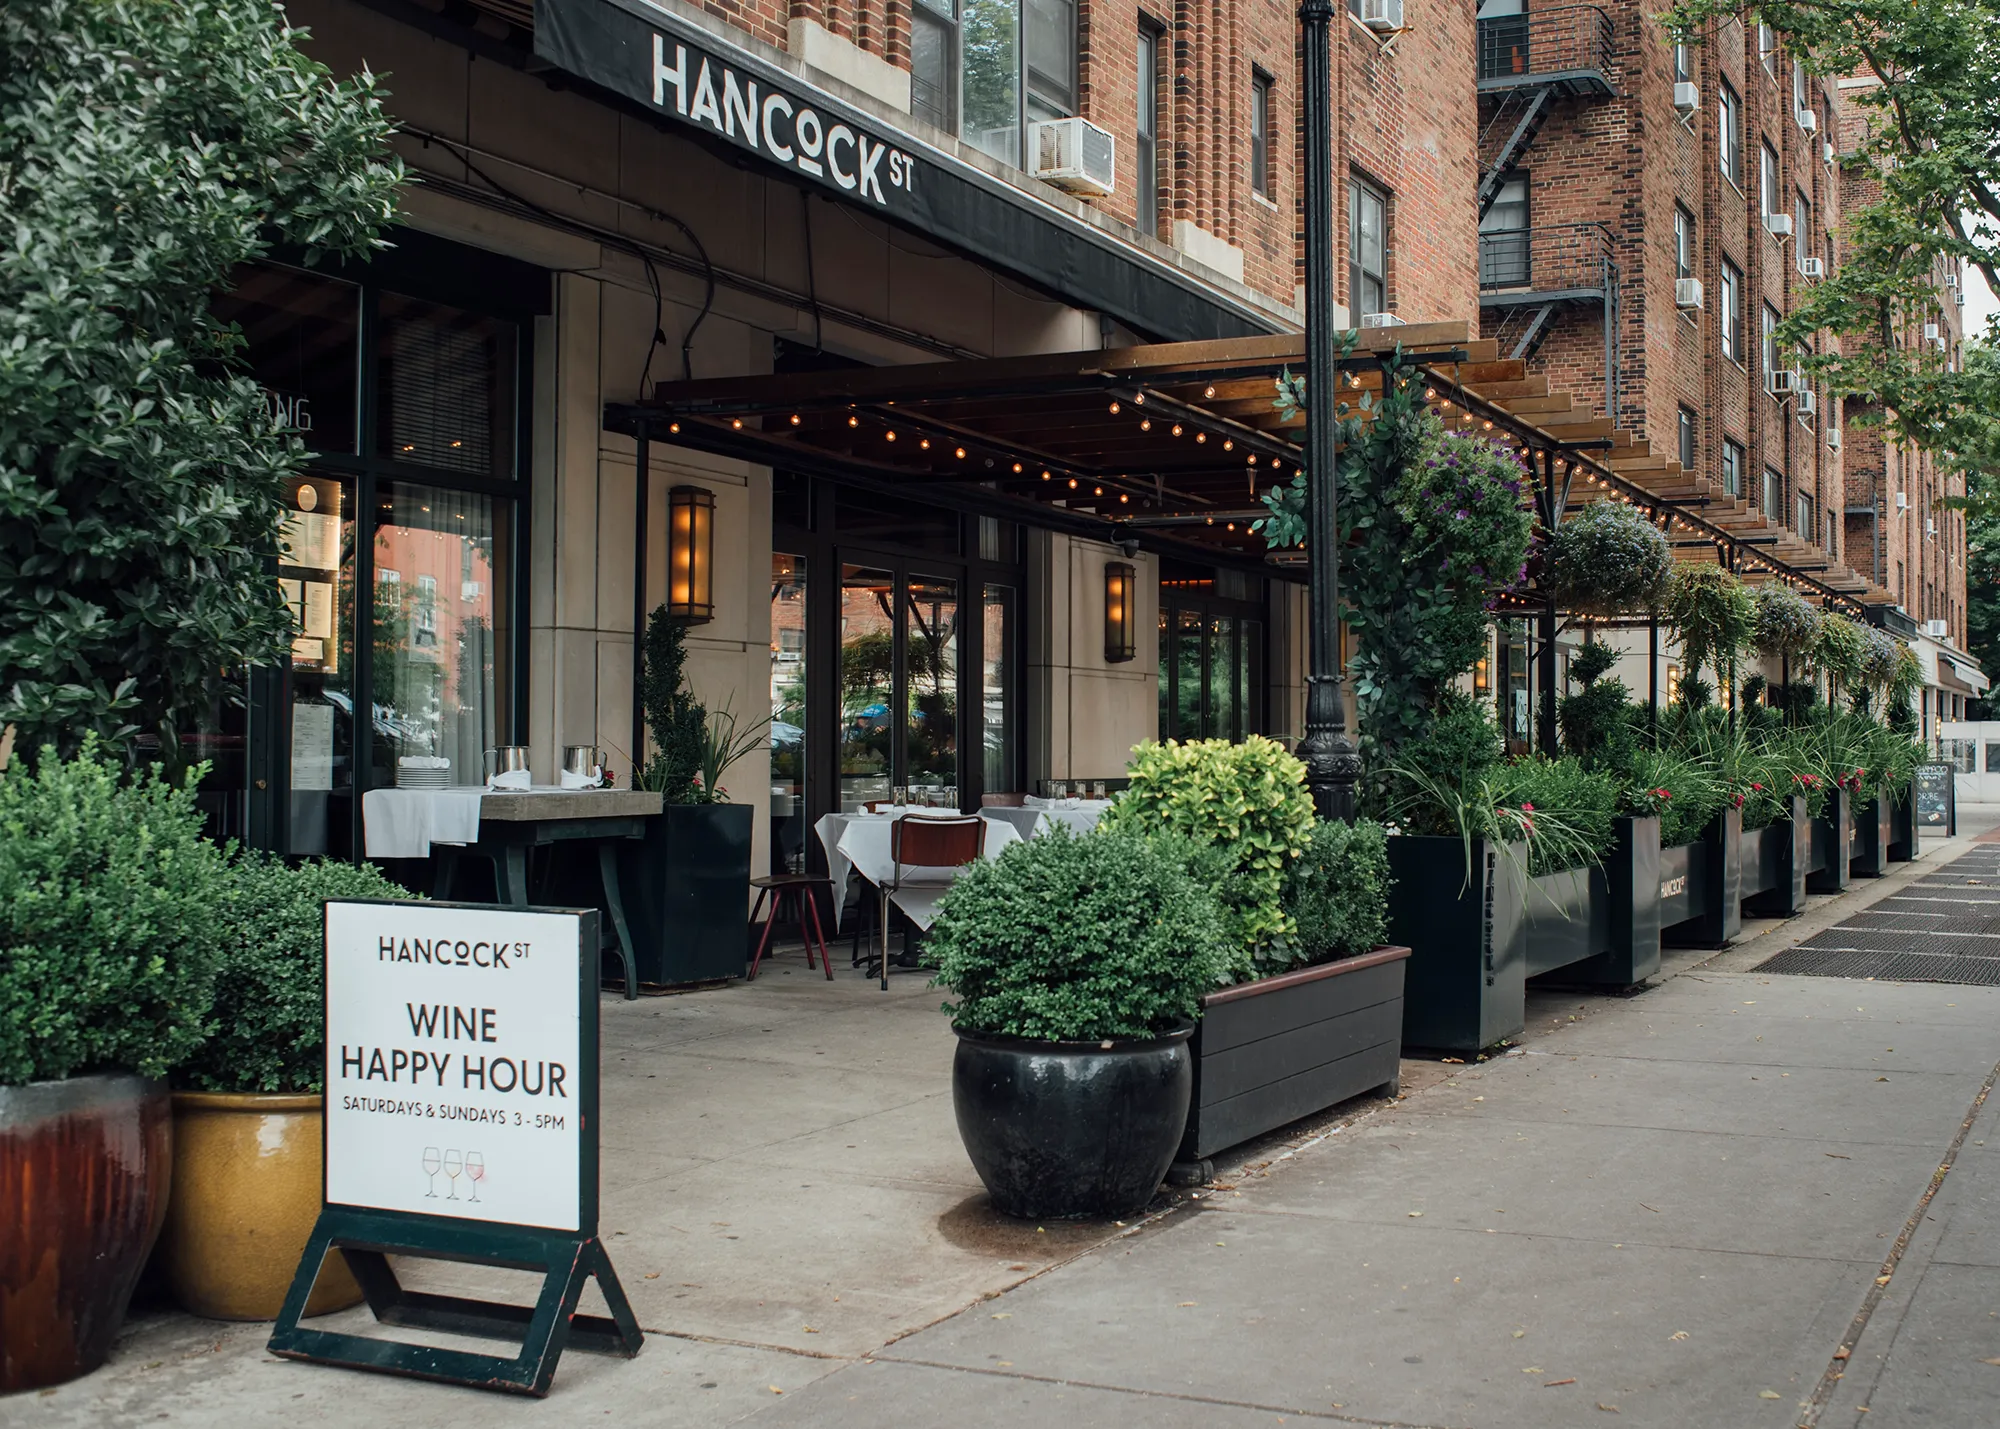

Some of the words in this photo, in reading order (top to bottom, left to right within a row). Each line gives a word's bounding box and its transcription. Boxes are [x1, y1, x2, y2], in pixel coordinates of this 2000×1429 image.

[653, 33, 886, 205] HANCOCK
[889, 149, 914, 192] ST
[379, 936, 510, 969] HANCOCK
[514, 943, 531, 958] ST
[407, 1002, 497, 1042] WINE
[341, 1045, 451, 1086] HAPPY
[463, 1055, 567, 1098] HOUR
[343, 1096, 422, 1116] SATURDAYS
[426, 1105, 436, 1117] &
[439, 1105, 506, 1124] SUNDAYS
